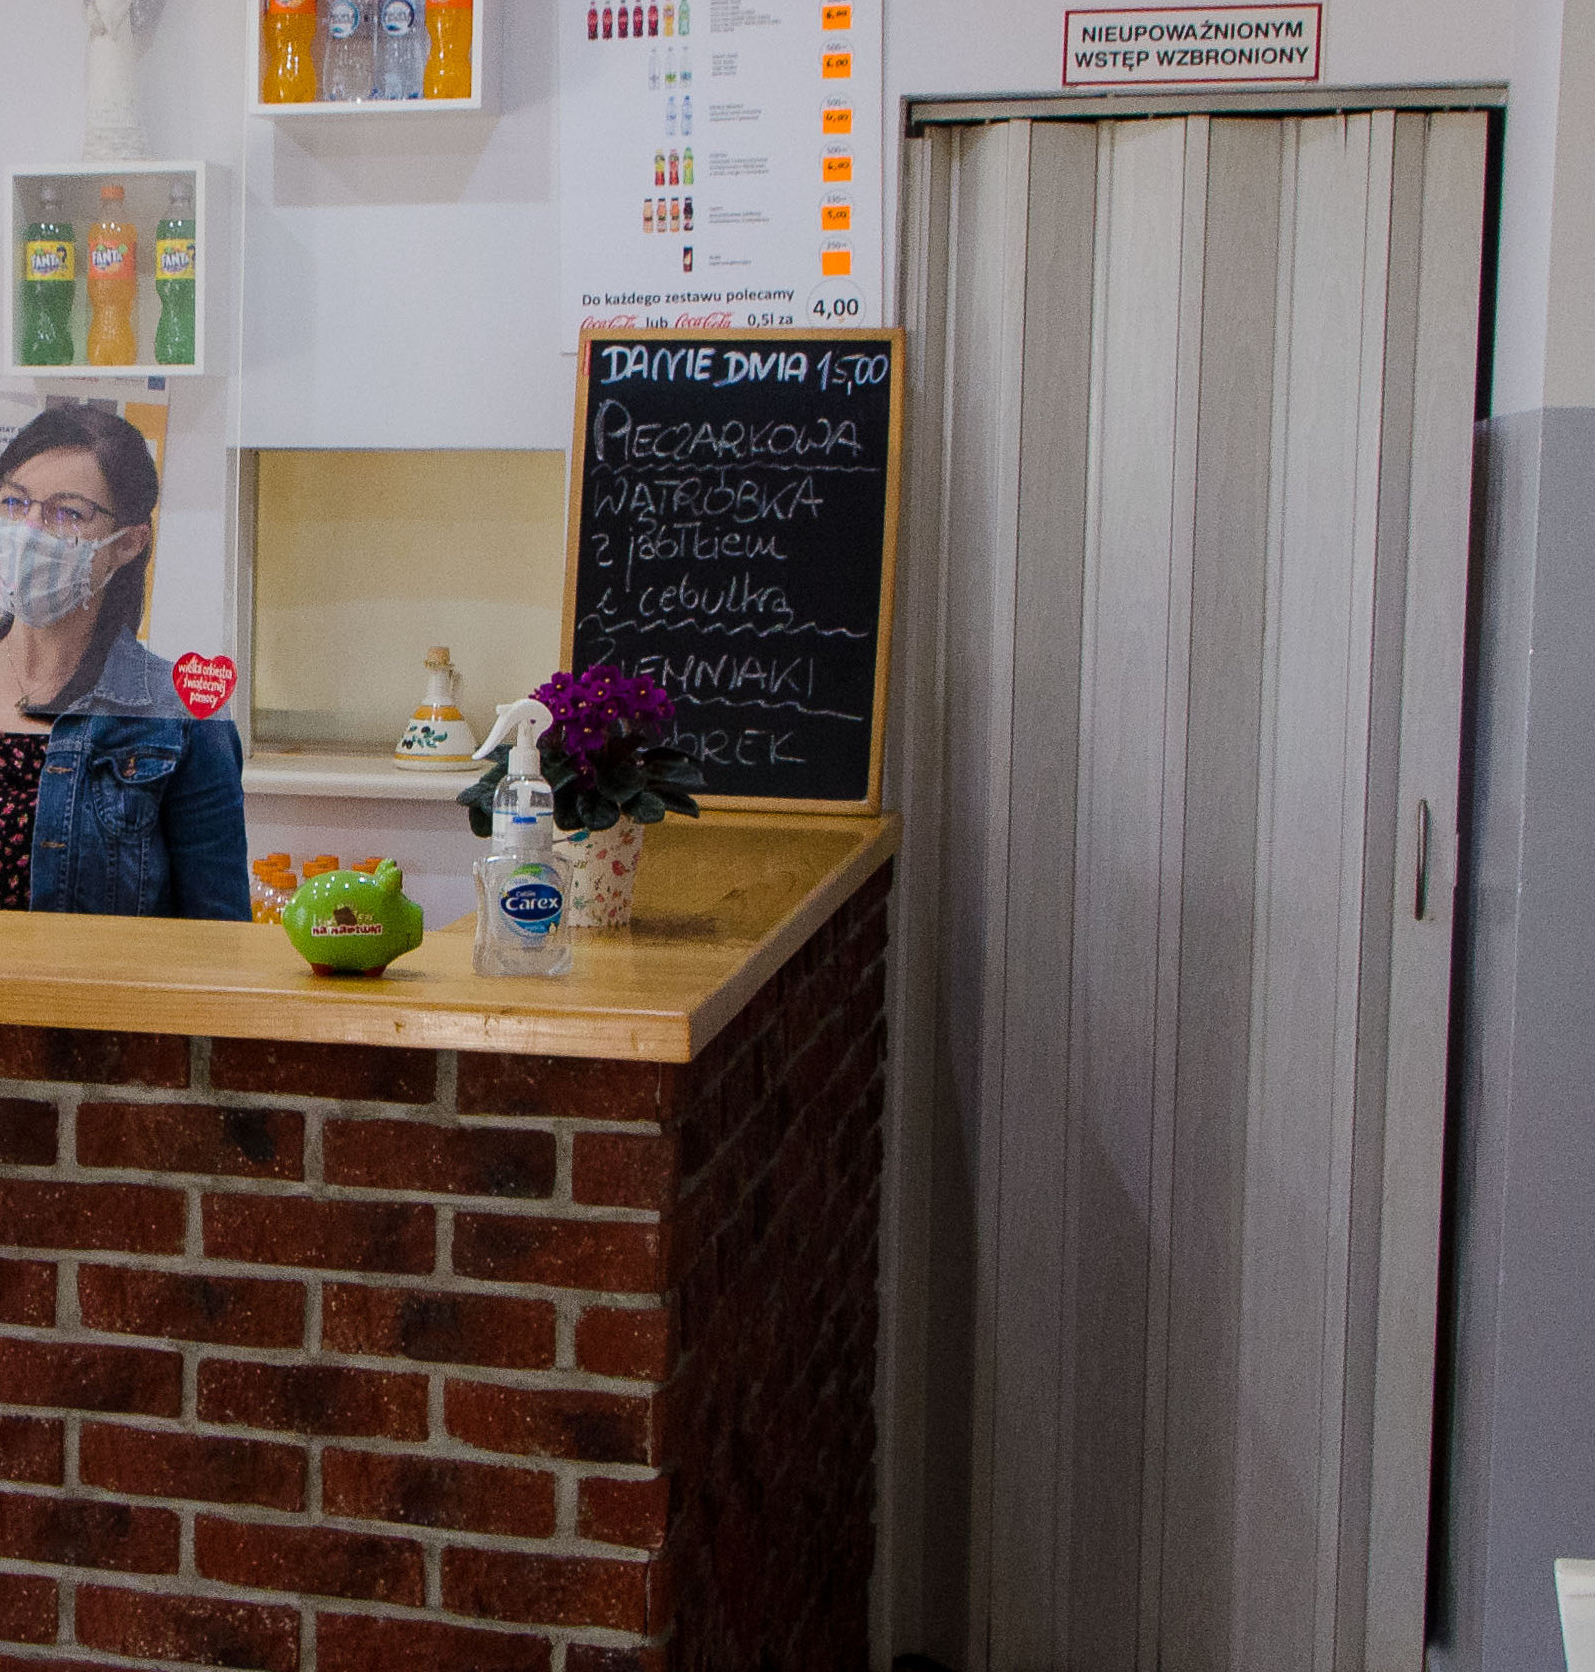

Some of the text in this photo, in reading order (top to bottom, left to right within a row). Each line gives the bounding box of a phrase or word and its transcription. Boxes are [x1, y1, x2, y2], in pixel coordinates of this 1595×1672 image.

[1081, 20, 1304, 44] NIEUPOWAŻNIONYM
[1074, 46, 1310, 71] WSTĘP WZBRONIONY
[92, 249, 123, 268] FANTA
[581, 287, 795, 308] Do każdego zestawu polecamy
[812, 298, 859, 319] 4,00
[645, 315, 668, 328] lub
[778, 314, 794, 325] za
[600, 345, 889, 396] DANIE DNIA 15,00
[592, 399, 862, 462] PIECZARKOWA
[595, 469, 824, 532] WĄTRÓBKA
[178, 655, 202, 674] wielka
[189, 692, 219, 709] pomocy
[505, 897, 559, 911] Carex
